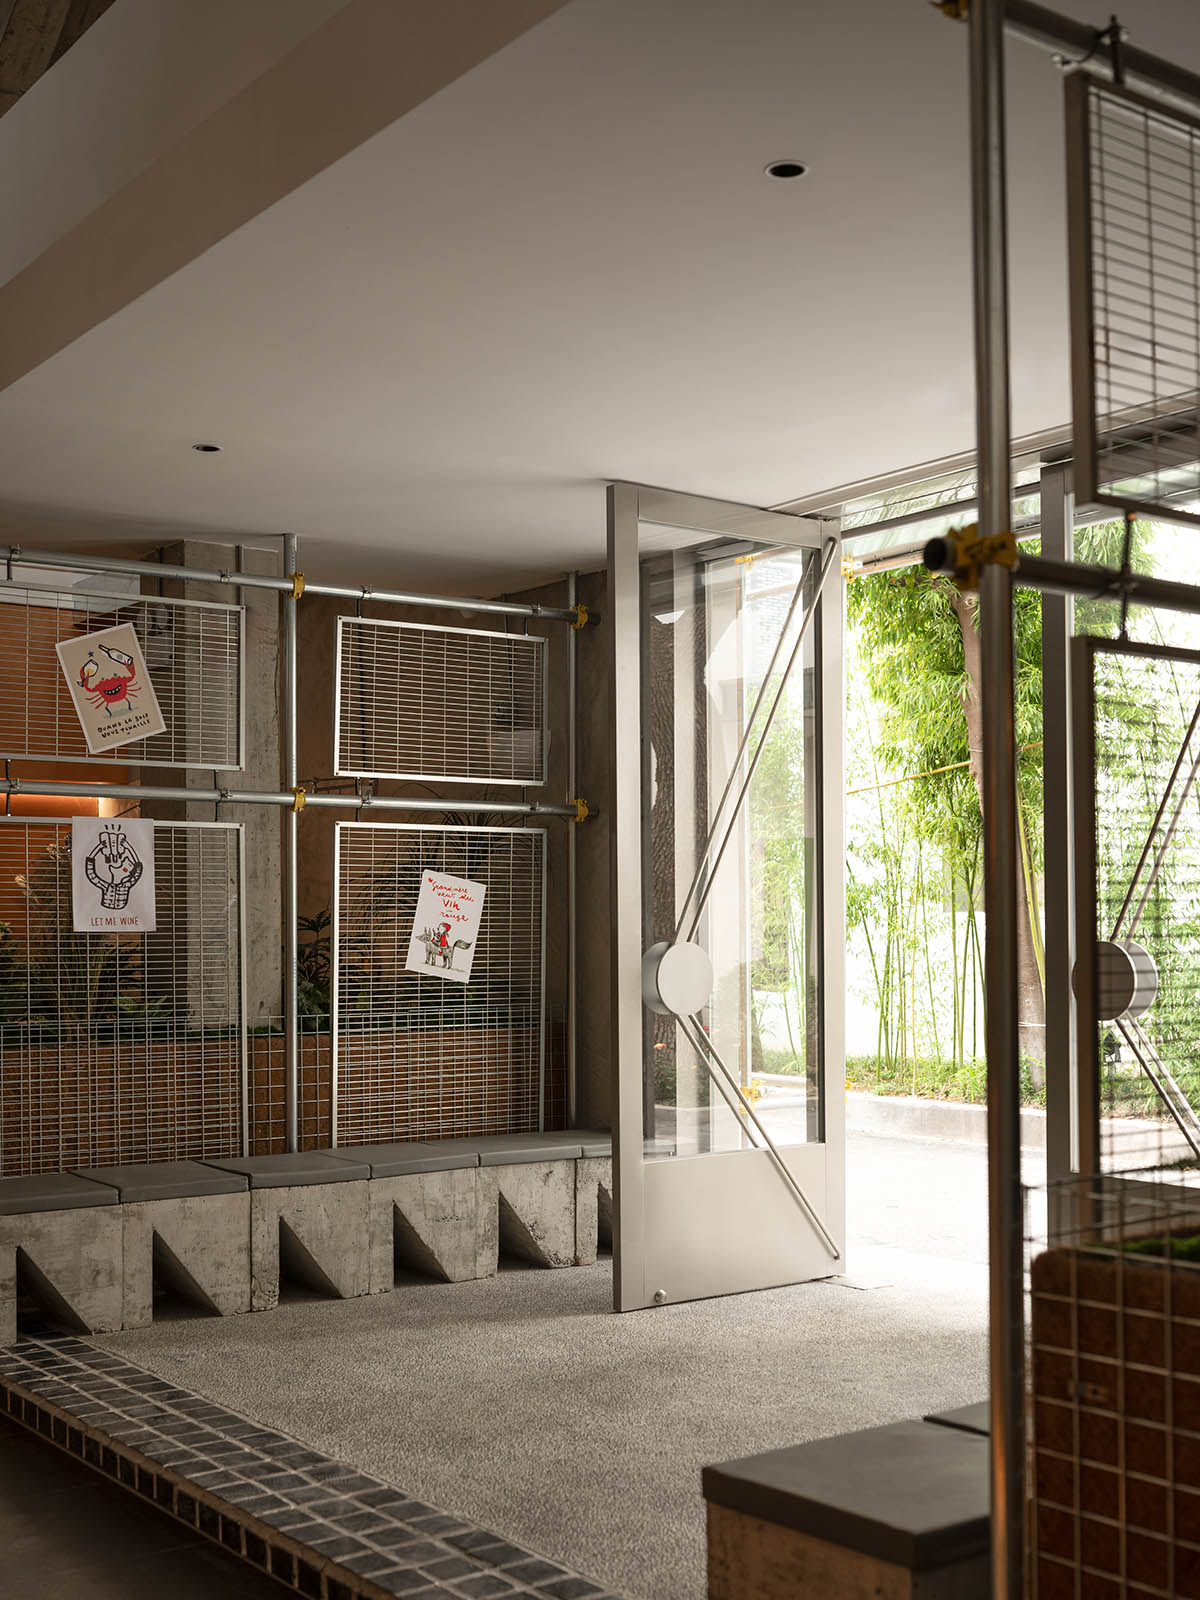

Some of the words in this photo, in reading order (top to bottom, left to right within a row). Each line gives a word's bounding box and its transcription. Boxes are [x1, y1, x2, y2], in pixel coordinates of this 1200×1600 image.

[91, 917, 104, 927] LET
[105, 917, 117, 926] ME
[119, 916, 140, 926] WINE
